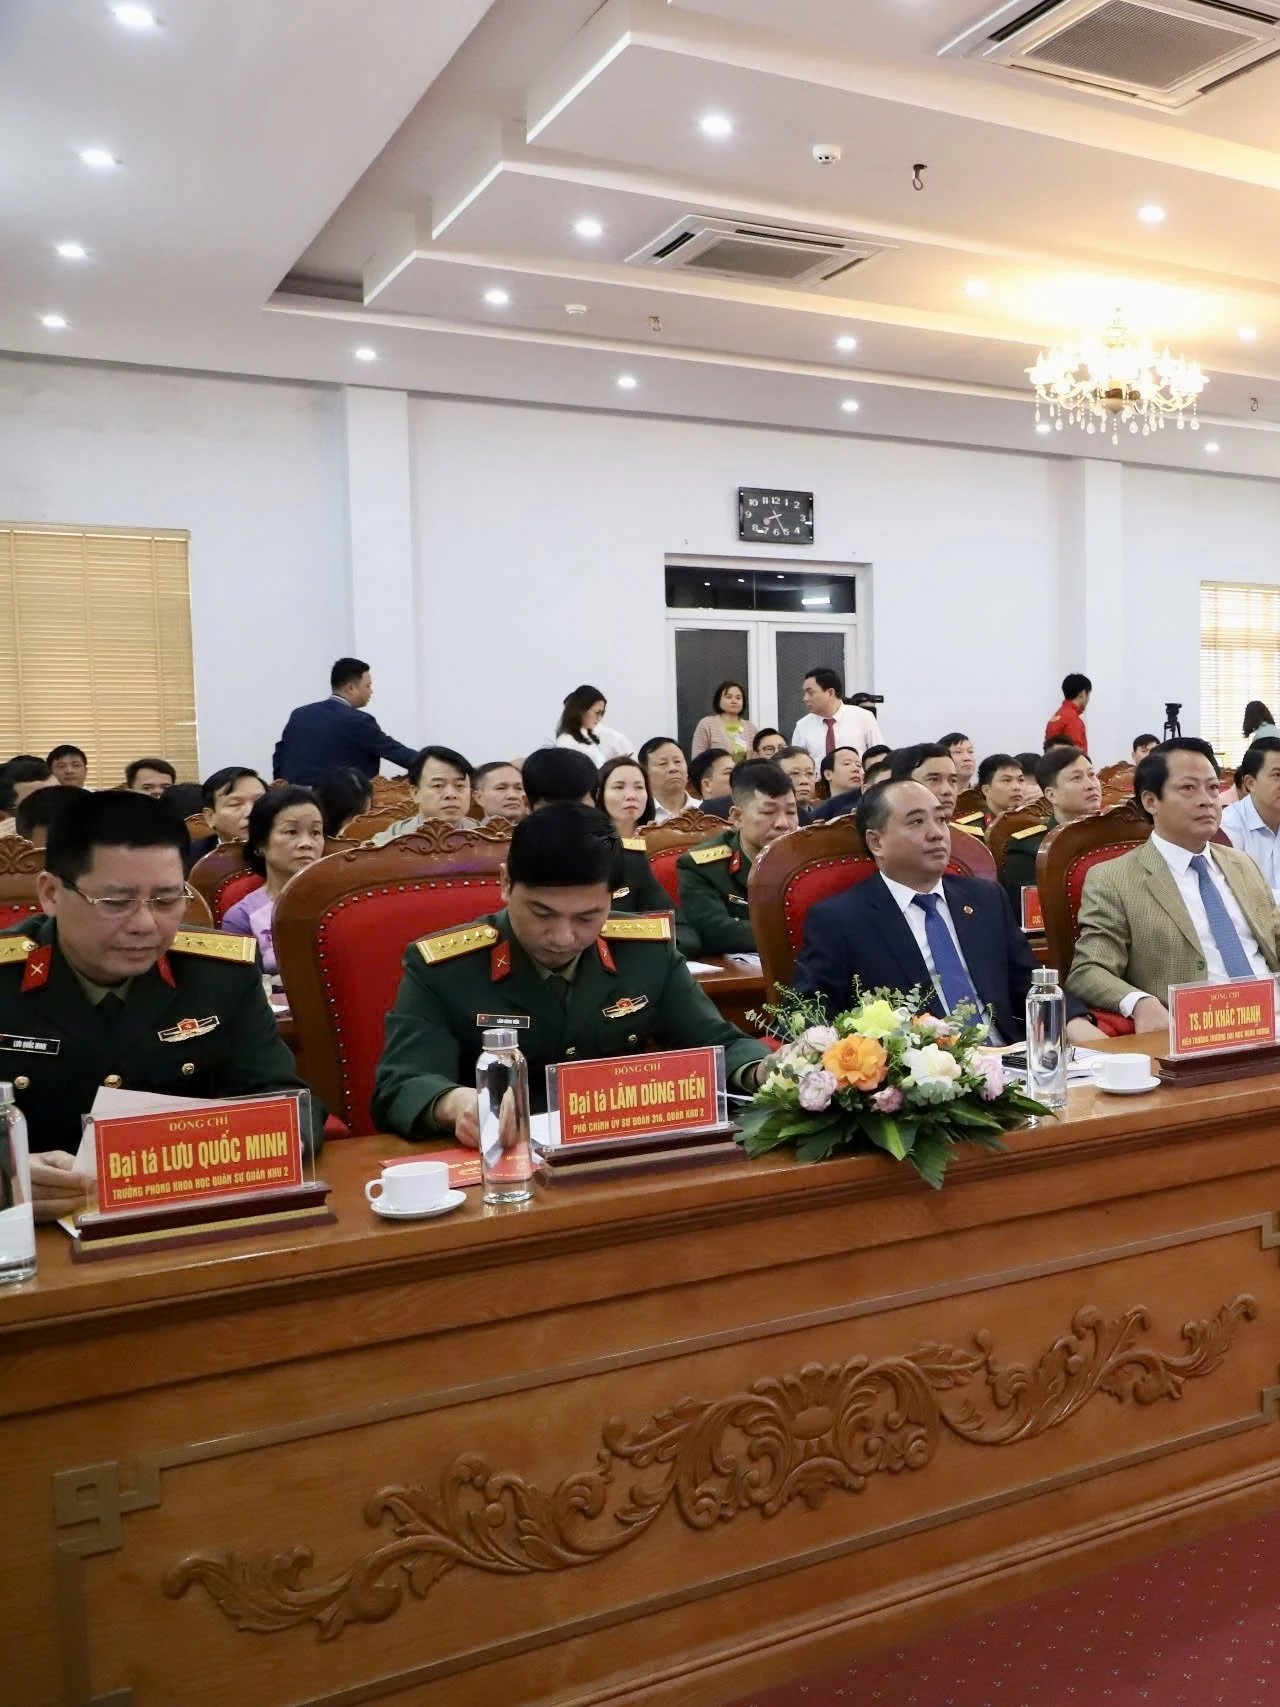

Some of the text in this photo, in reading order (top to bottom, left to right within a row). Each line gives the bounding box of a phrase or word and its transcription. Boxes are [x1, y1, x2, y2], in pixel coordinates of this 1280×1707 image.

[749, 499, 759, 507] 10
[762, 497, 769, 505] 11
[772, 497, 781, 505] 12
[794, 501, 800, 509] 2
[745, 511, 752, 519] 9
[794, 527, 800, 535] 4
[1189, 1012, 1201, 1031] TS.
[569, 1071, 706, 1119] Đại tá LÂM DŨNG TIẾN
[573, 1122, 587, 1134] PHÓ
[700, 1108, 705, 1117] 2
[110, 1129, 288, 1183] Đại tá LƯU QUỐC MINH
[173, 1180, 193, 1192] KHOA
[268, 1167, 282, 1179] KHU
[284, 1166, 289, 1177] 2
